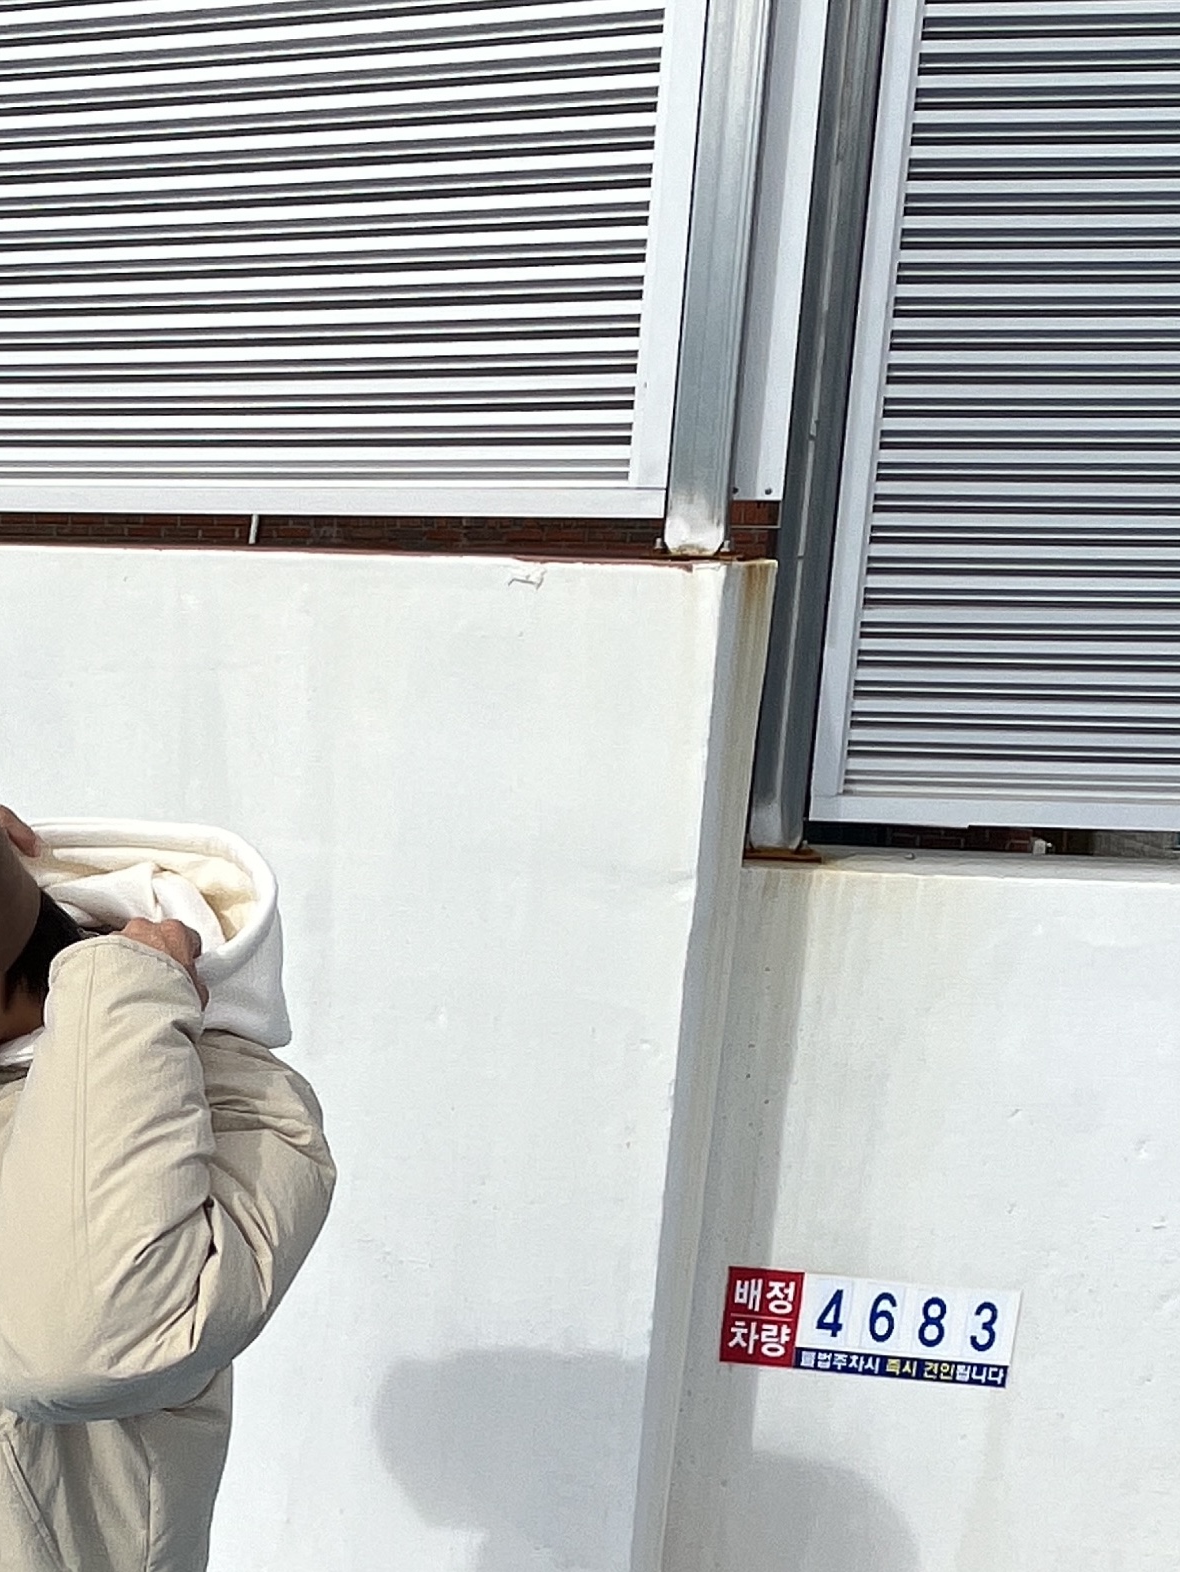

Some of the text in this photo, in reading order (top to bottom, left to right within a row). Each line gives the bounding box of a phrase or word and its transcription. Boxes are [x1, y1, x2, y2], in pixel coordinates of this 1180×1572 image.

[734, 1278, 796, 1315] 배정
[815, 1288, 999, 1352] 4683
[728, 1320, 792, 1358] 차량
[800, 1350, 880, 1375] 불법주차시
[885, 1358, 918, 1377] 즉시
